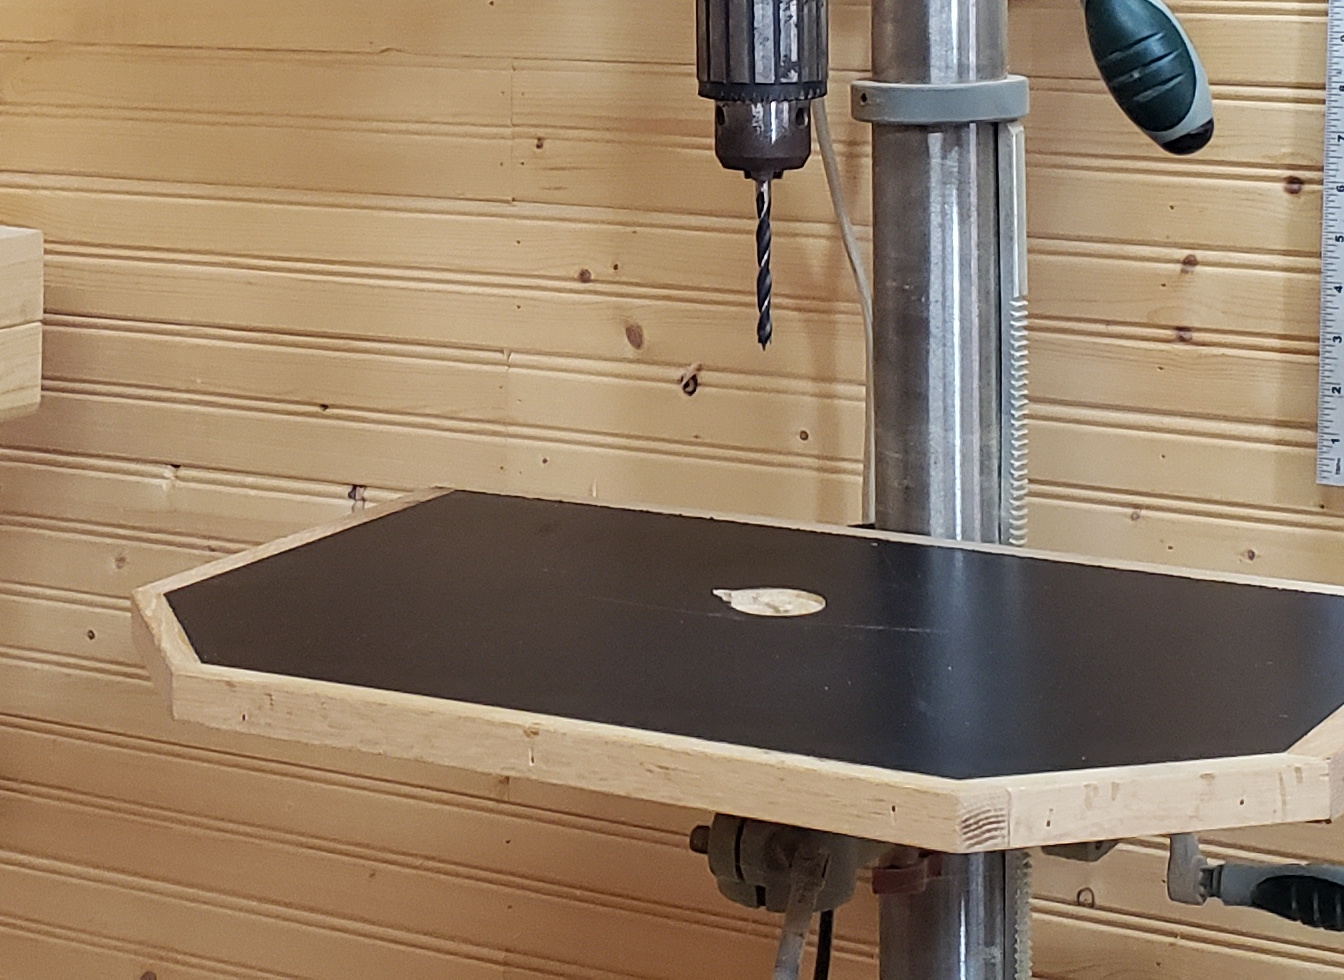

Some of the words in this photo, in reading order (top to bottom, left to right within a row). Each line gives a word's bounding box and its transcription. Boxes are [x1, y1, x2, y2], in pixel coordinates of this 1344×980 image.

[1335, 235, 1344, 243] 5
[1333, 285, 1343, 294] 4
[1332, 335, 1342, 343] 3
[1331, 386, 1341, 394] 2
